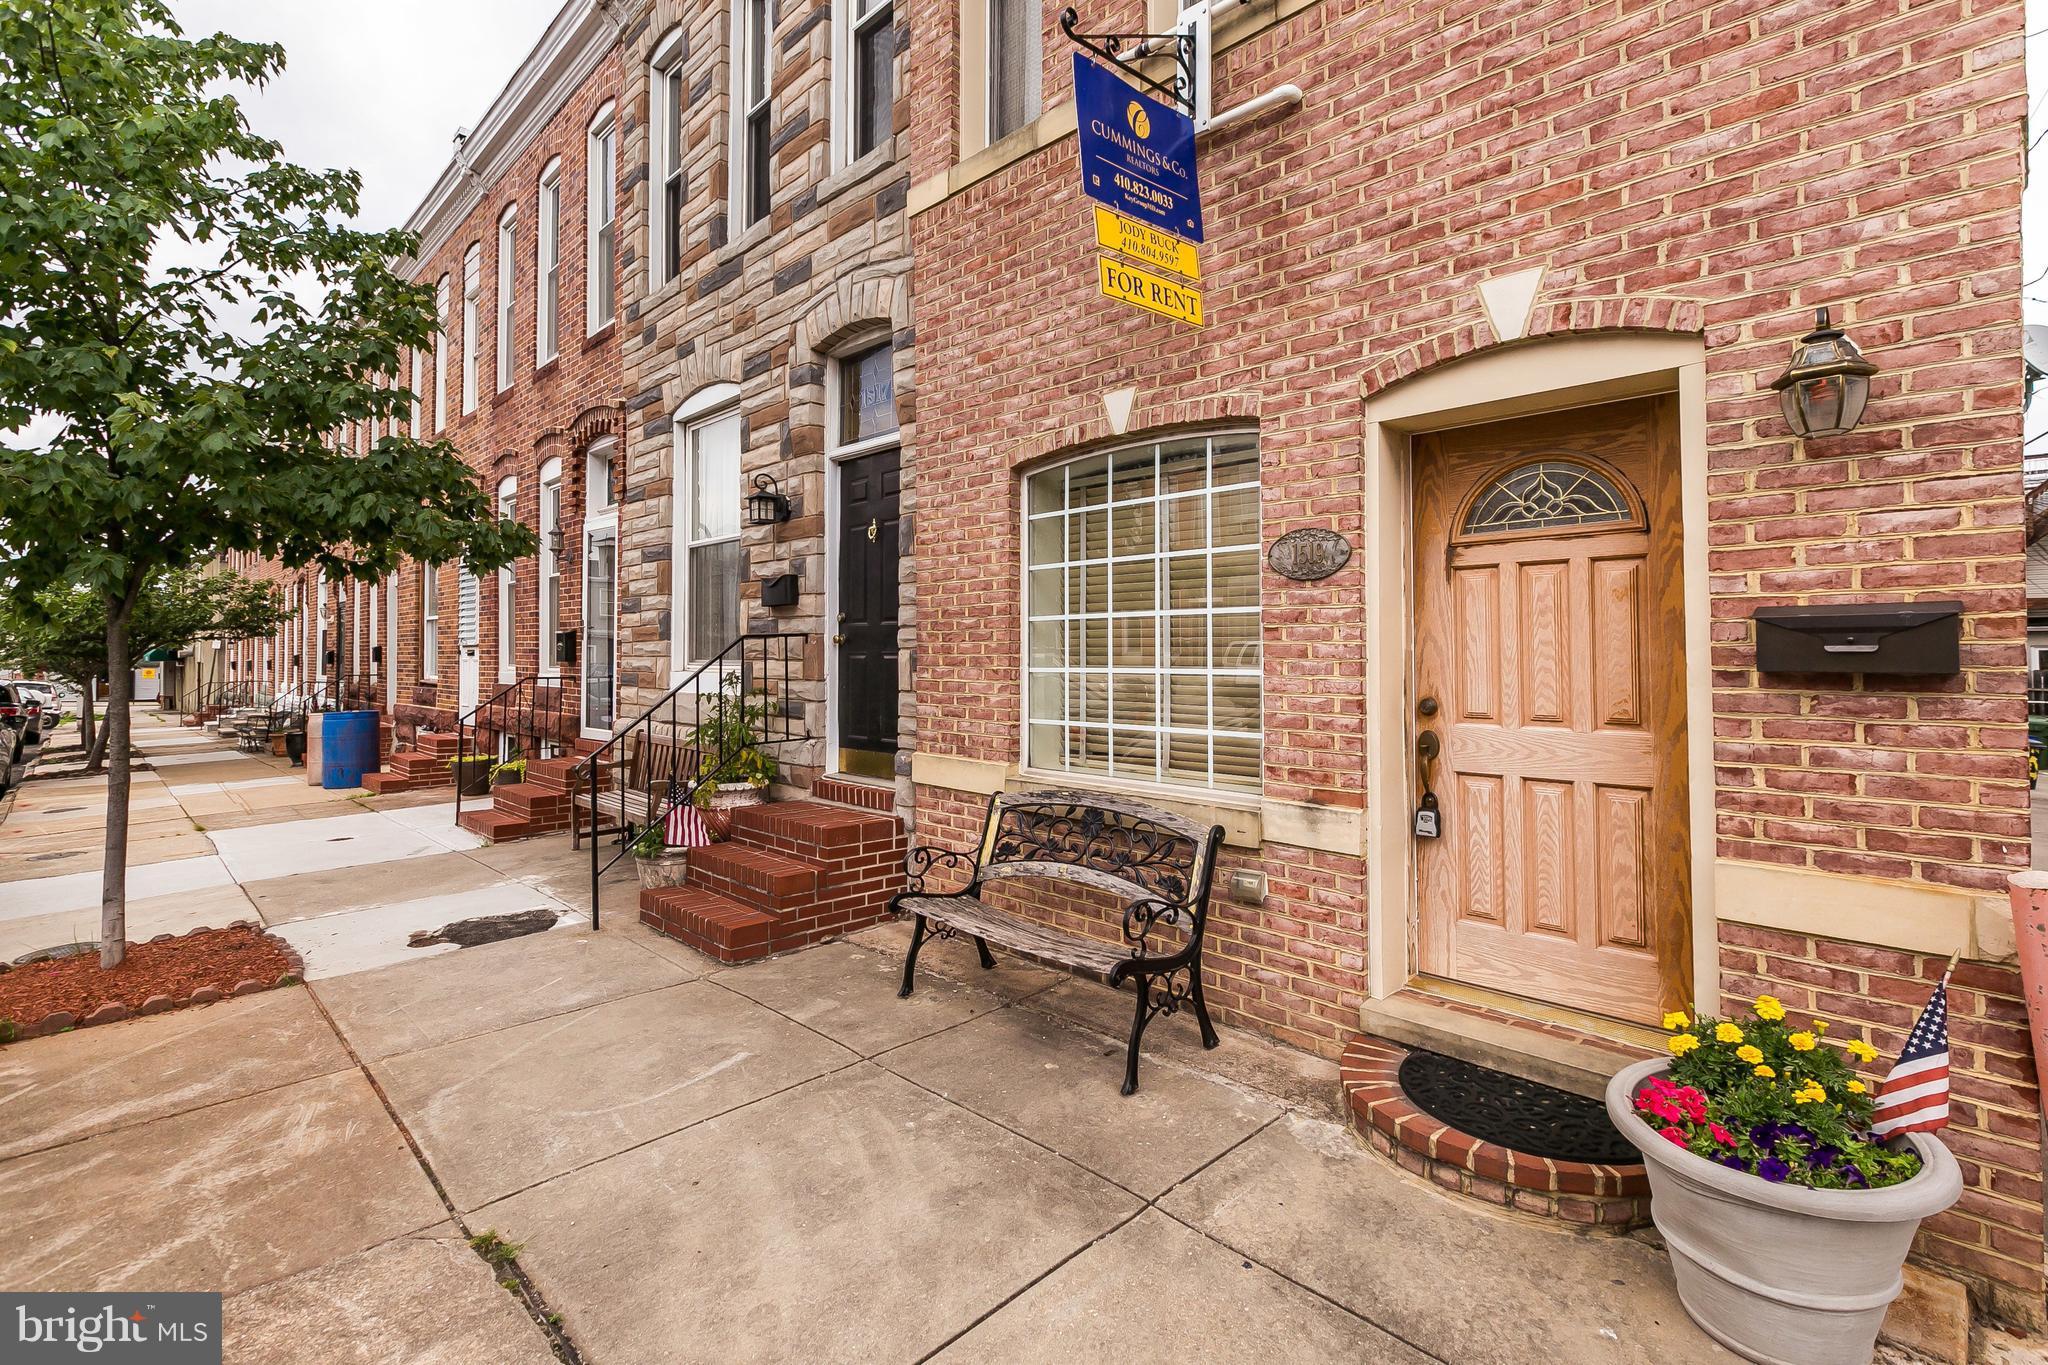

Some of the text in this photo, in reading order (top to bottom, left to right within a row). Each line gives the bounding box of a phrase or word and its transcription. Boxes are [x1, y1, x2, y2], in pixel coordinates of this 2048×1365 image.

[1126, 154, 1160, 177] REALTORS
[1113, 173, 1174, 210] 410.823.0033
[1119, 220, 1180, 254] JODY BUCK
[1121, 237, 1180, 267] 410.804.9597
[1106, 266, 1198, 316] FOR RENT
[1291, 541, 1326, 566] 1519
